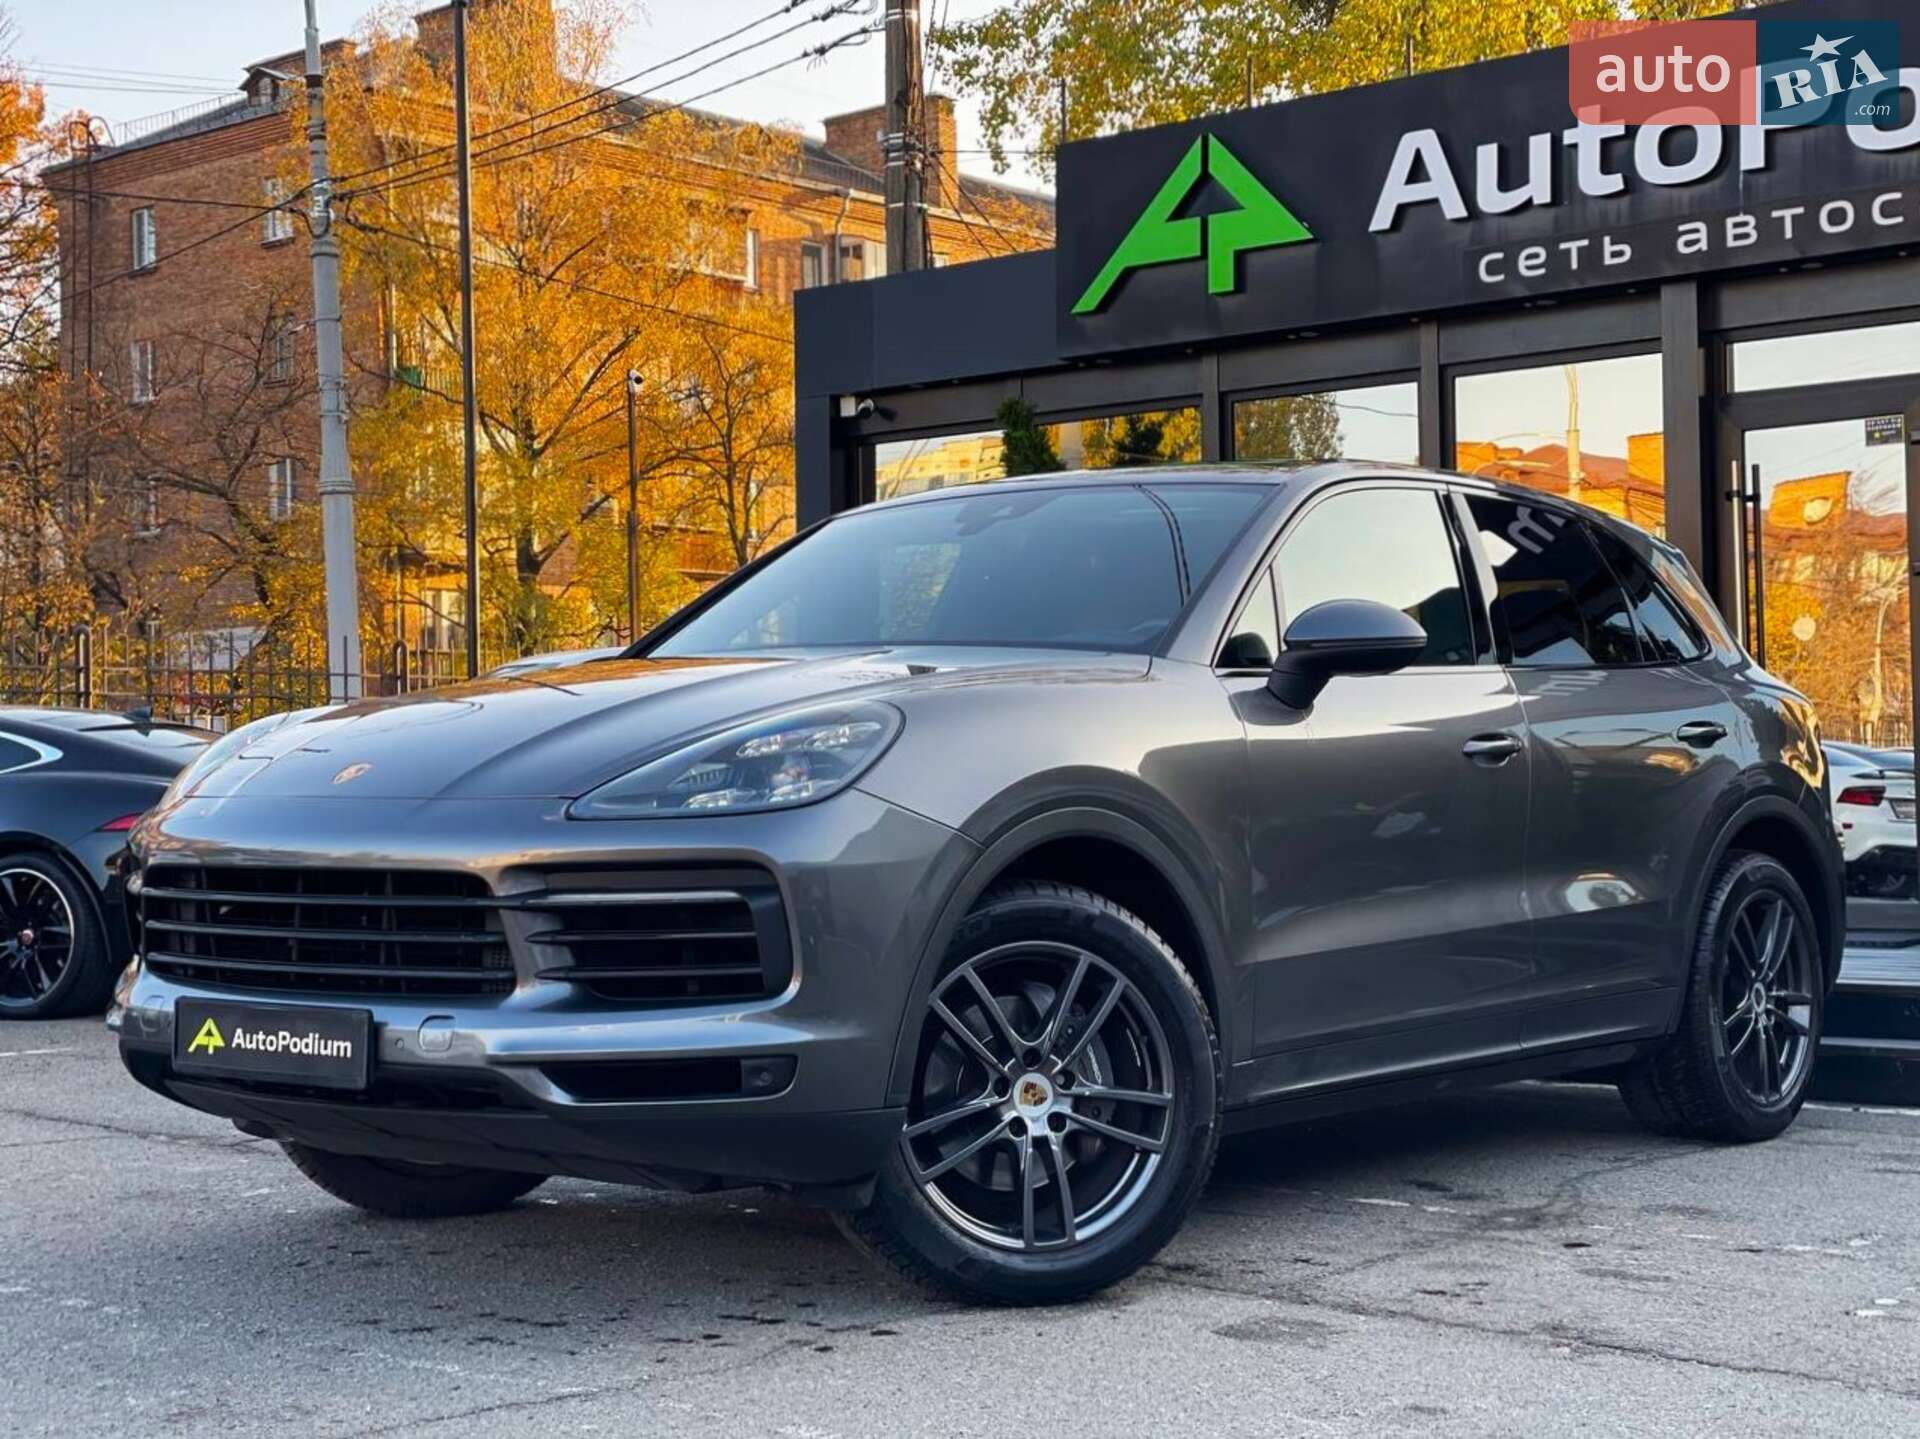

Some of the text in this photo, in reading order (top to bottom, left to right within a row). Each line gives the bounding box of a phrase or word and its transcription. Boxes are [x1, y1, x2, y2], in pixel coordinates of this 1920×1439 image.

[1478, 191, 1904, 283] сеть автос
[231, 1027, 352, 1058] AutoPodium
